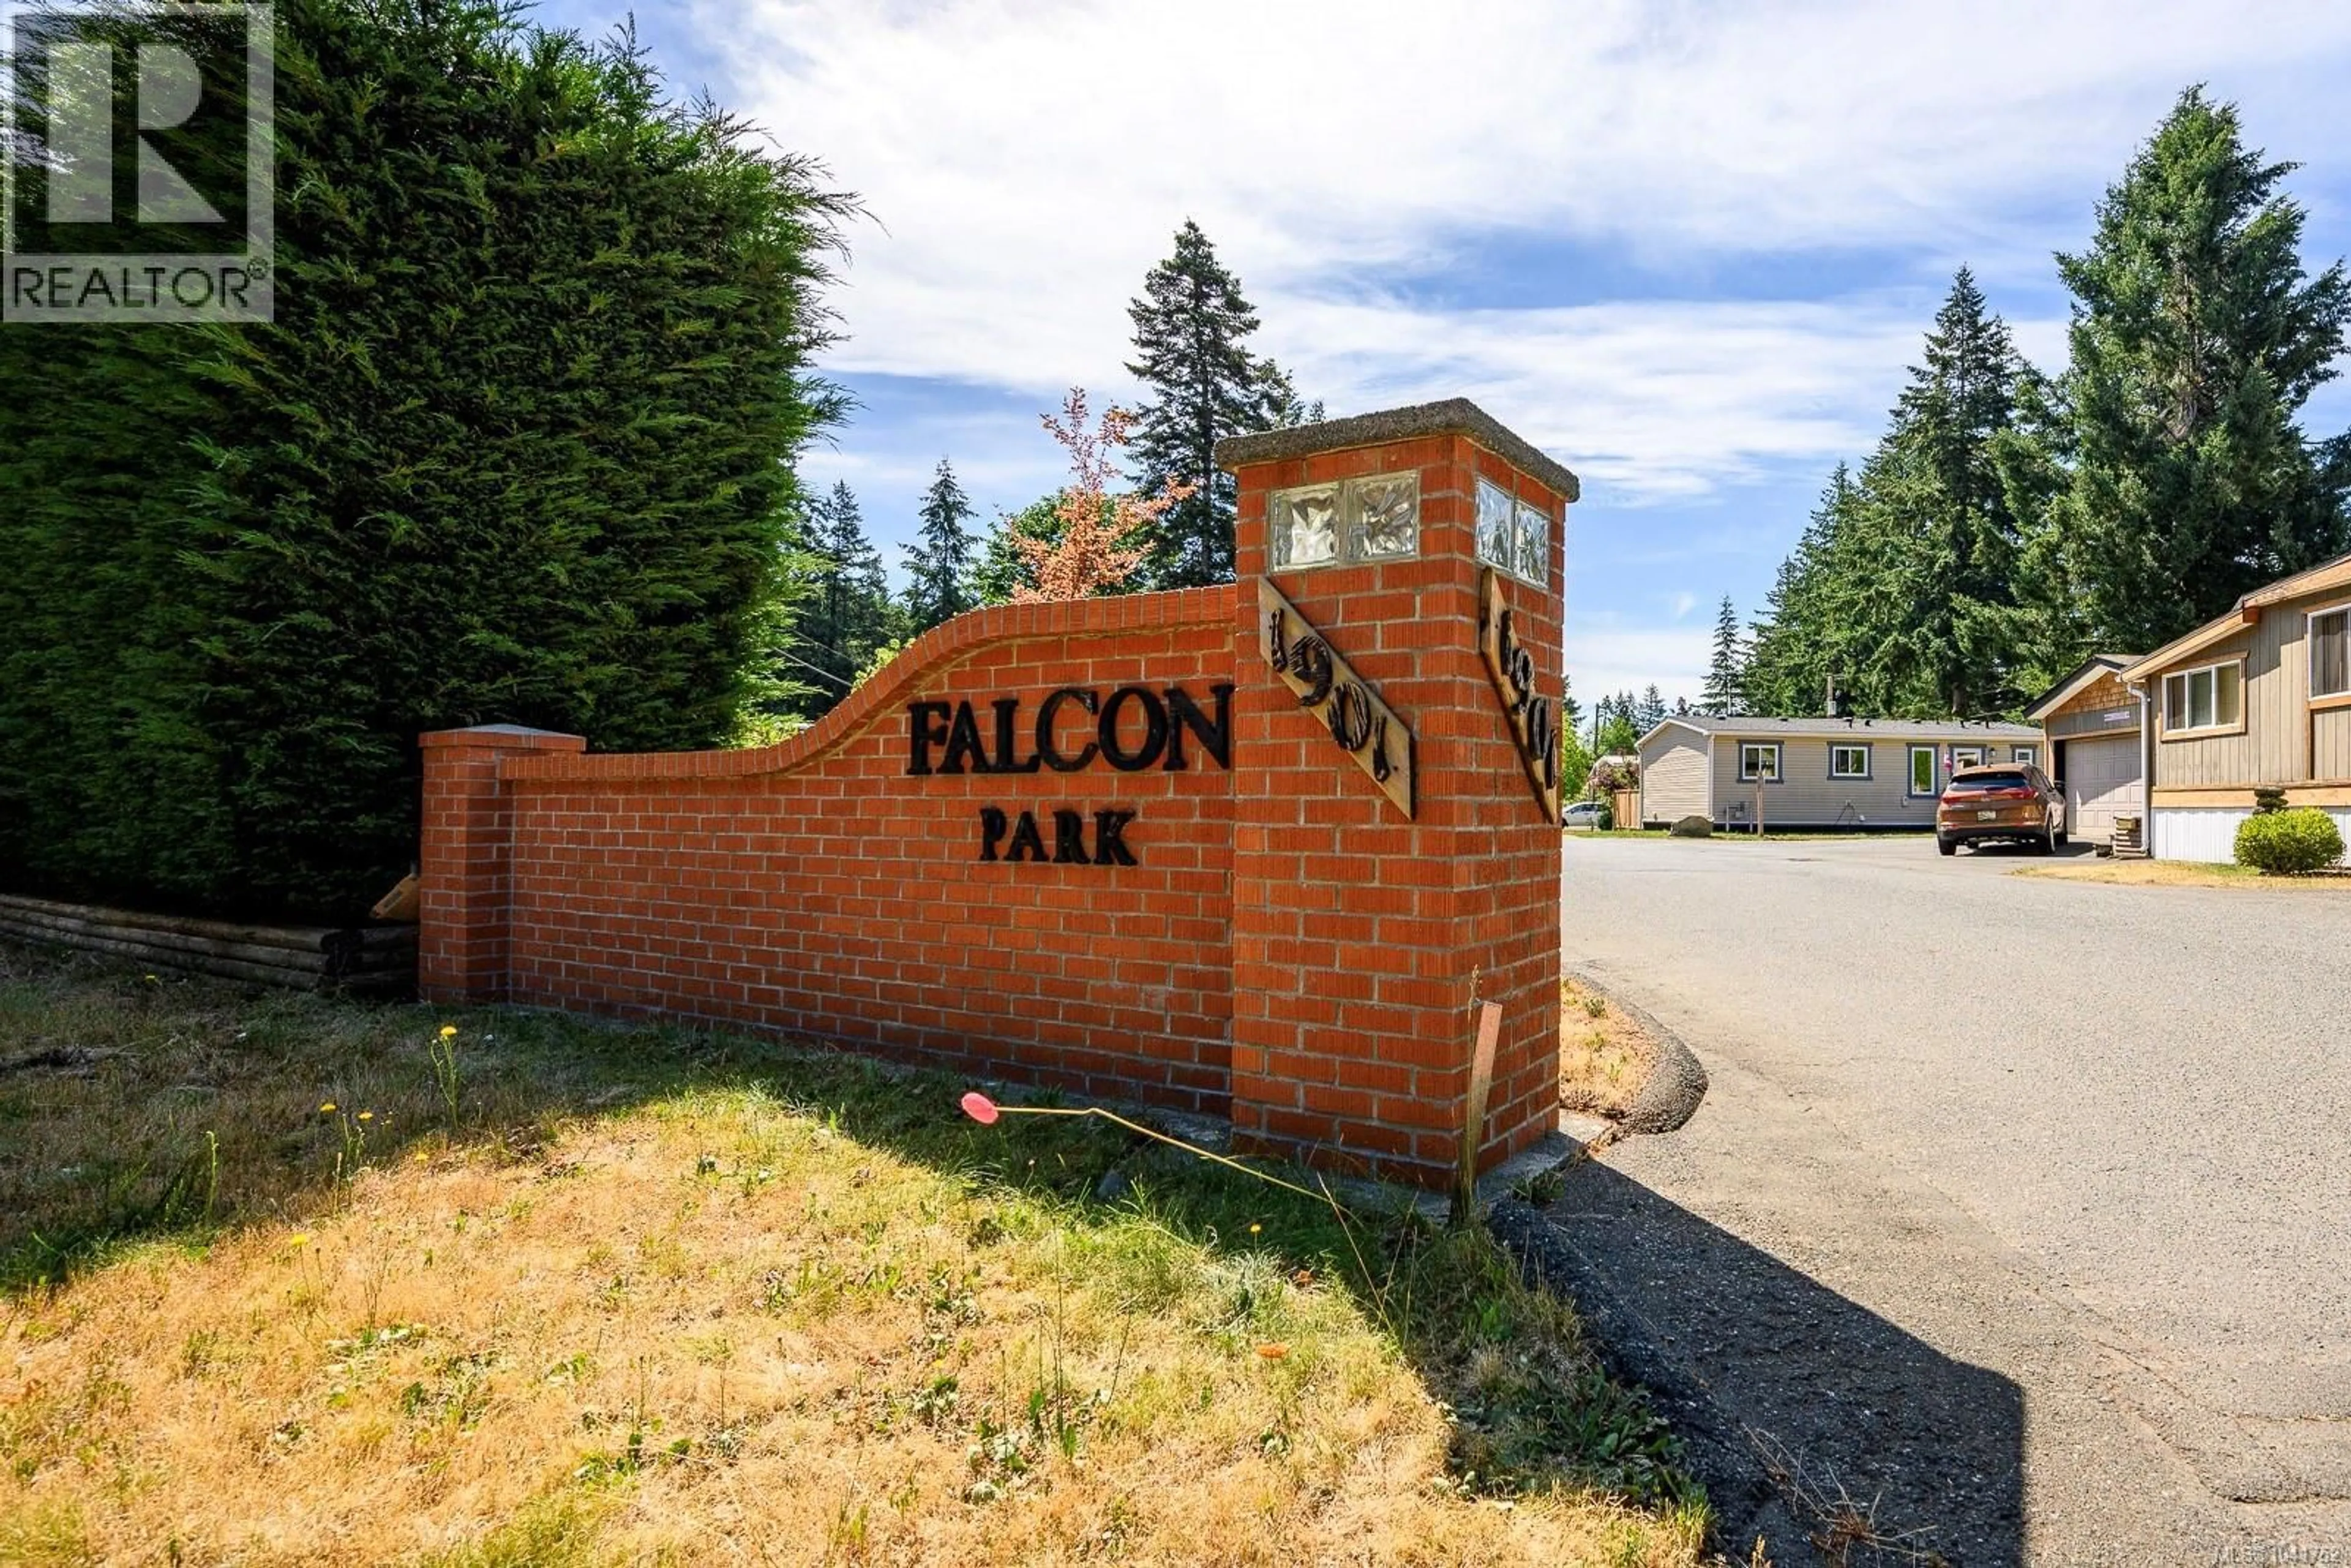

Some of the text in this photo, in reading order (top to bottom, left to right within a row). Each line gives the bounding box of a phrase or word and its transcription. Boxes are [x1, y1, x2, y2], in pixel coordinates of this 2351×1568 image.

[906, 682, 1234, 775] FALCON
[1270, 608, 1390, 782] 1901
[980, 807, 1138, 865] PARK
